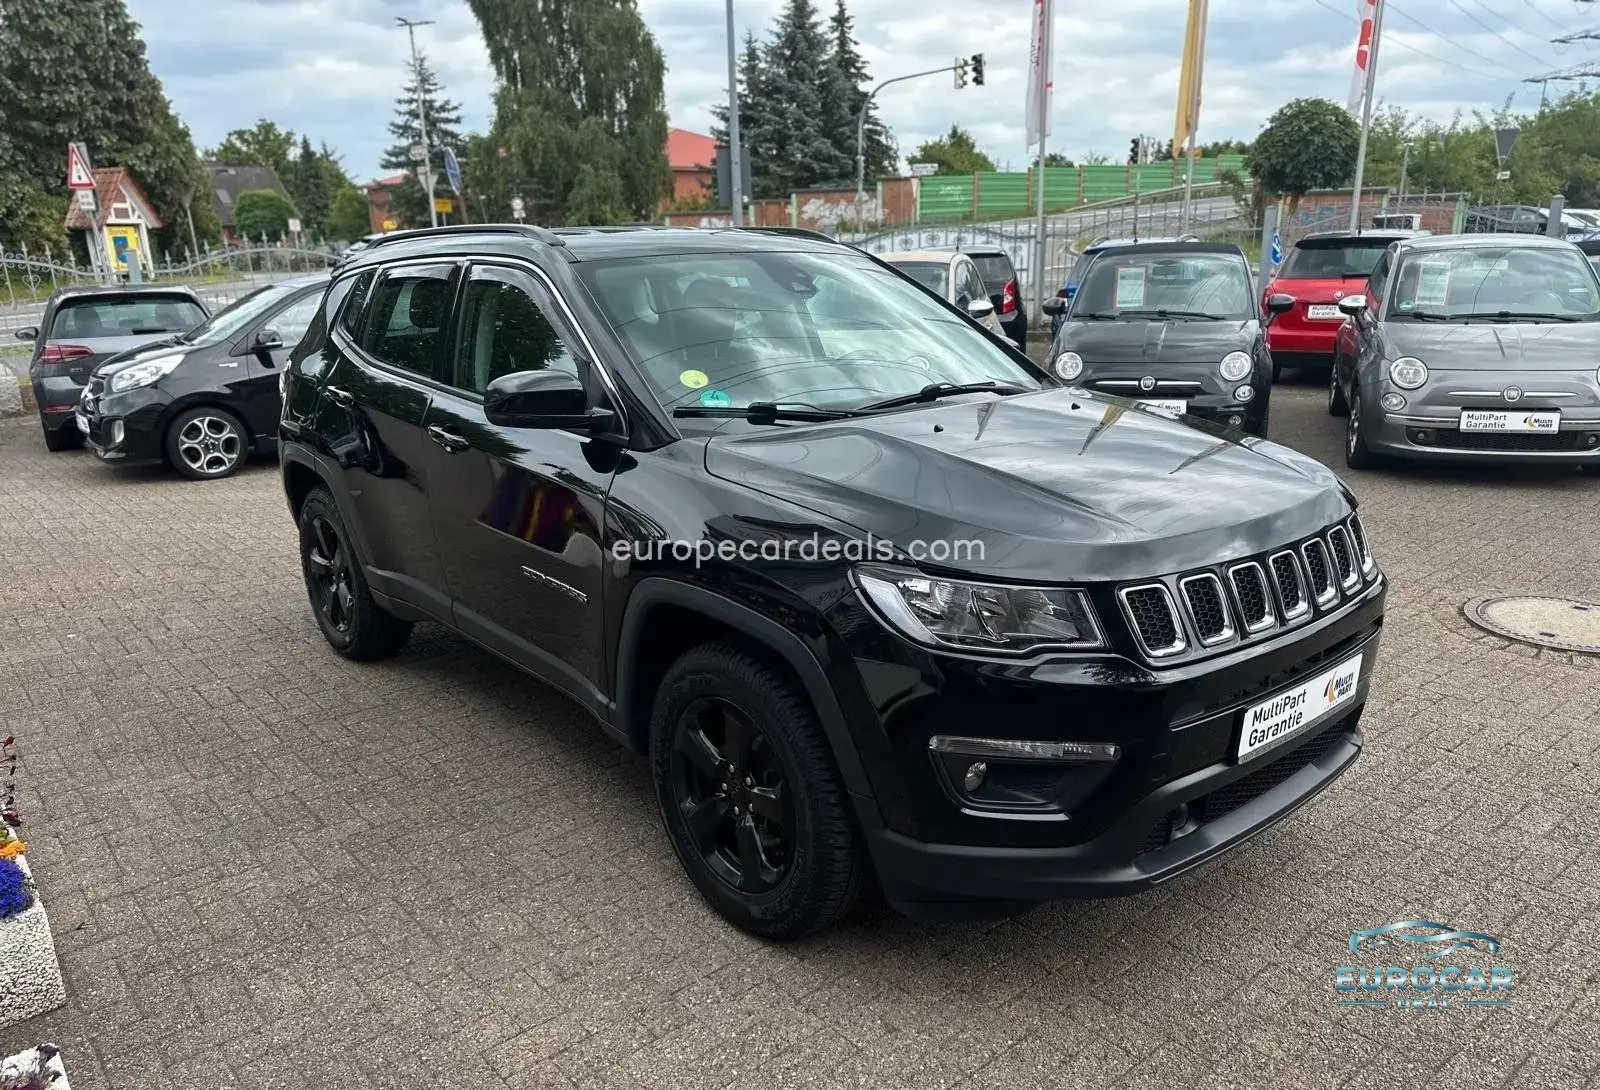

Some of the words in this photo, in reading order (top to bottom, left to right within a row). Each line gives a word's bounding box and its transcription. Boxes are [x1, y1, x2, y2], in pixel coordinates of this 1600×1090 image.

[711, 391, 719, 400] 4
[1466, 420, 1506, 429] Garantie
[1467, 413, 1507, 421] MultiPart
[1334, 671, 1354, 690] MULTI
[1337, 682, 1352, 698] PART
[1251, 688, 1307, 727] MultiPart
[1248, 710, 1303, 747] Garantie
